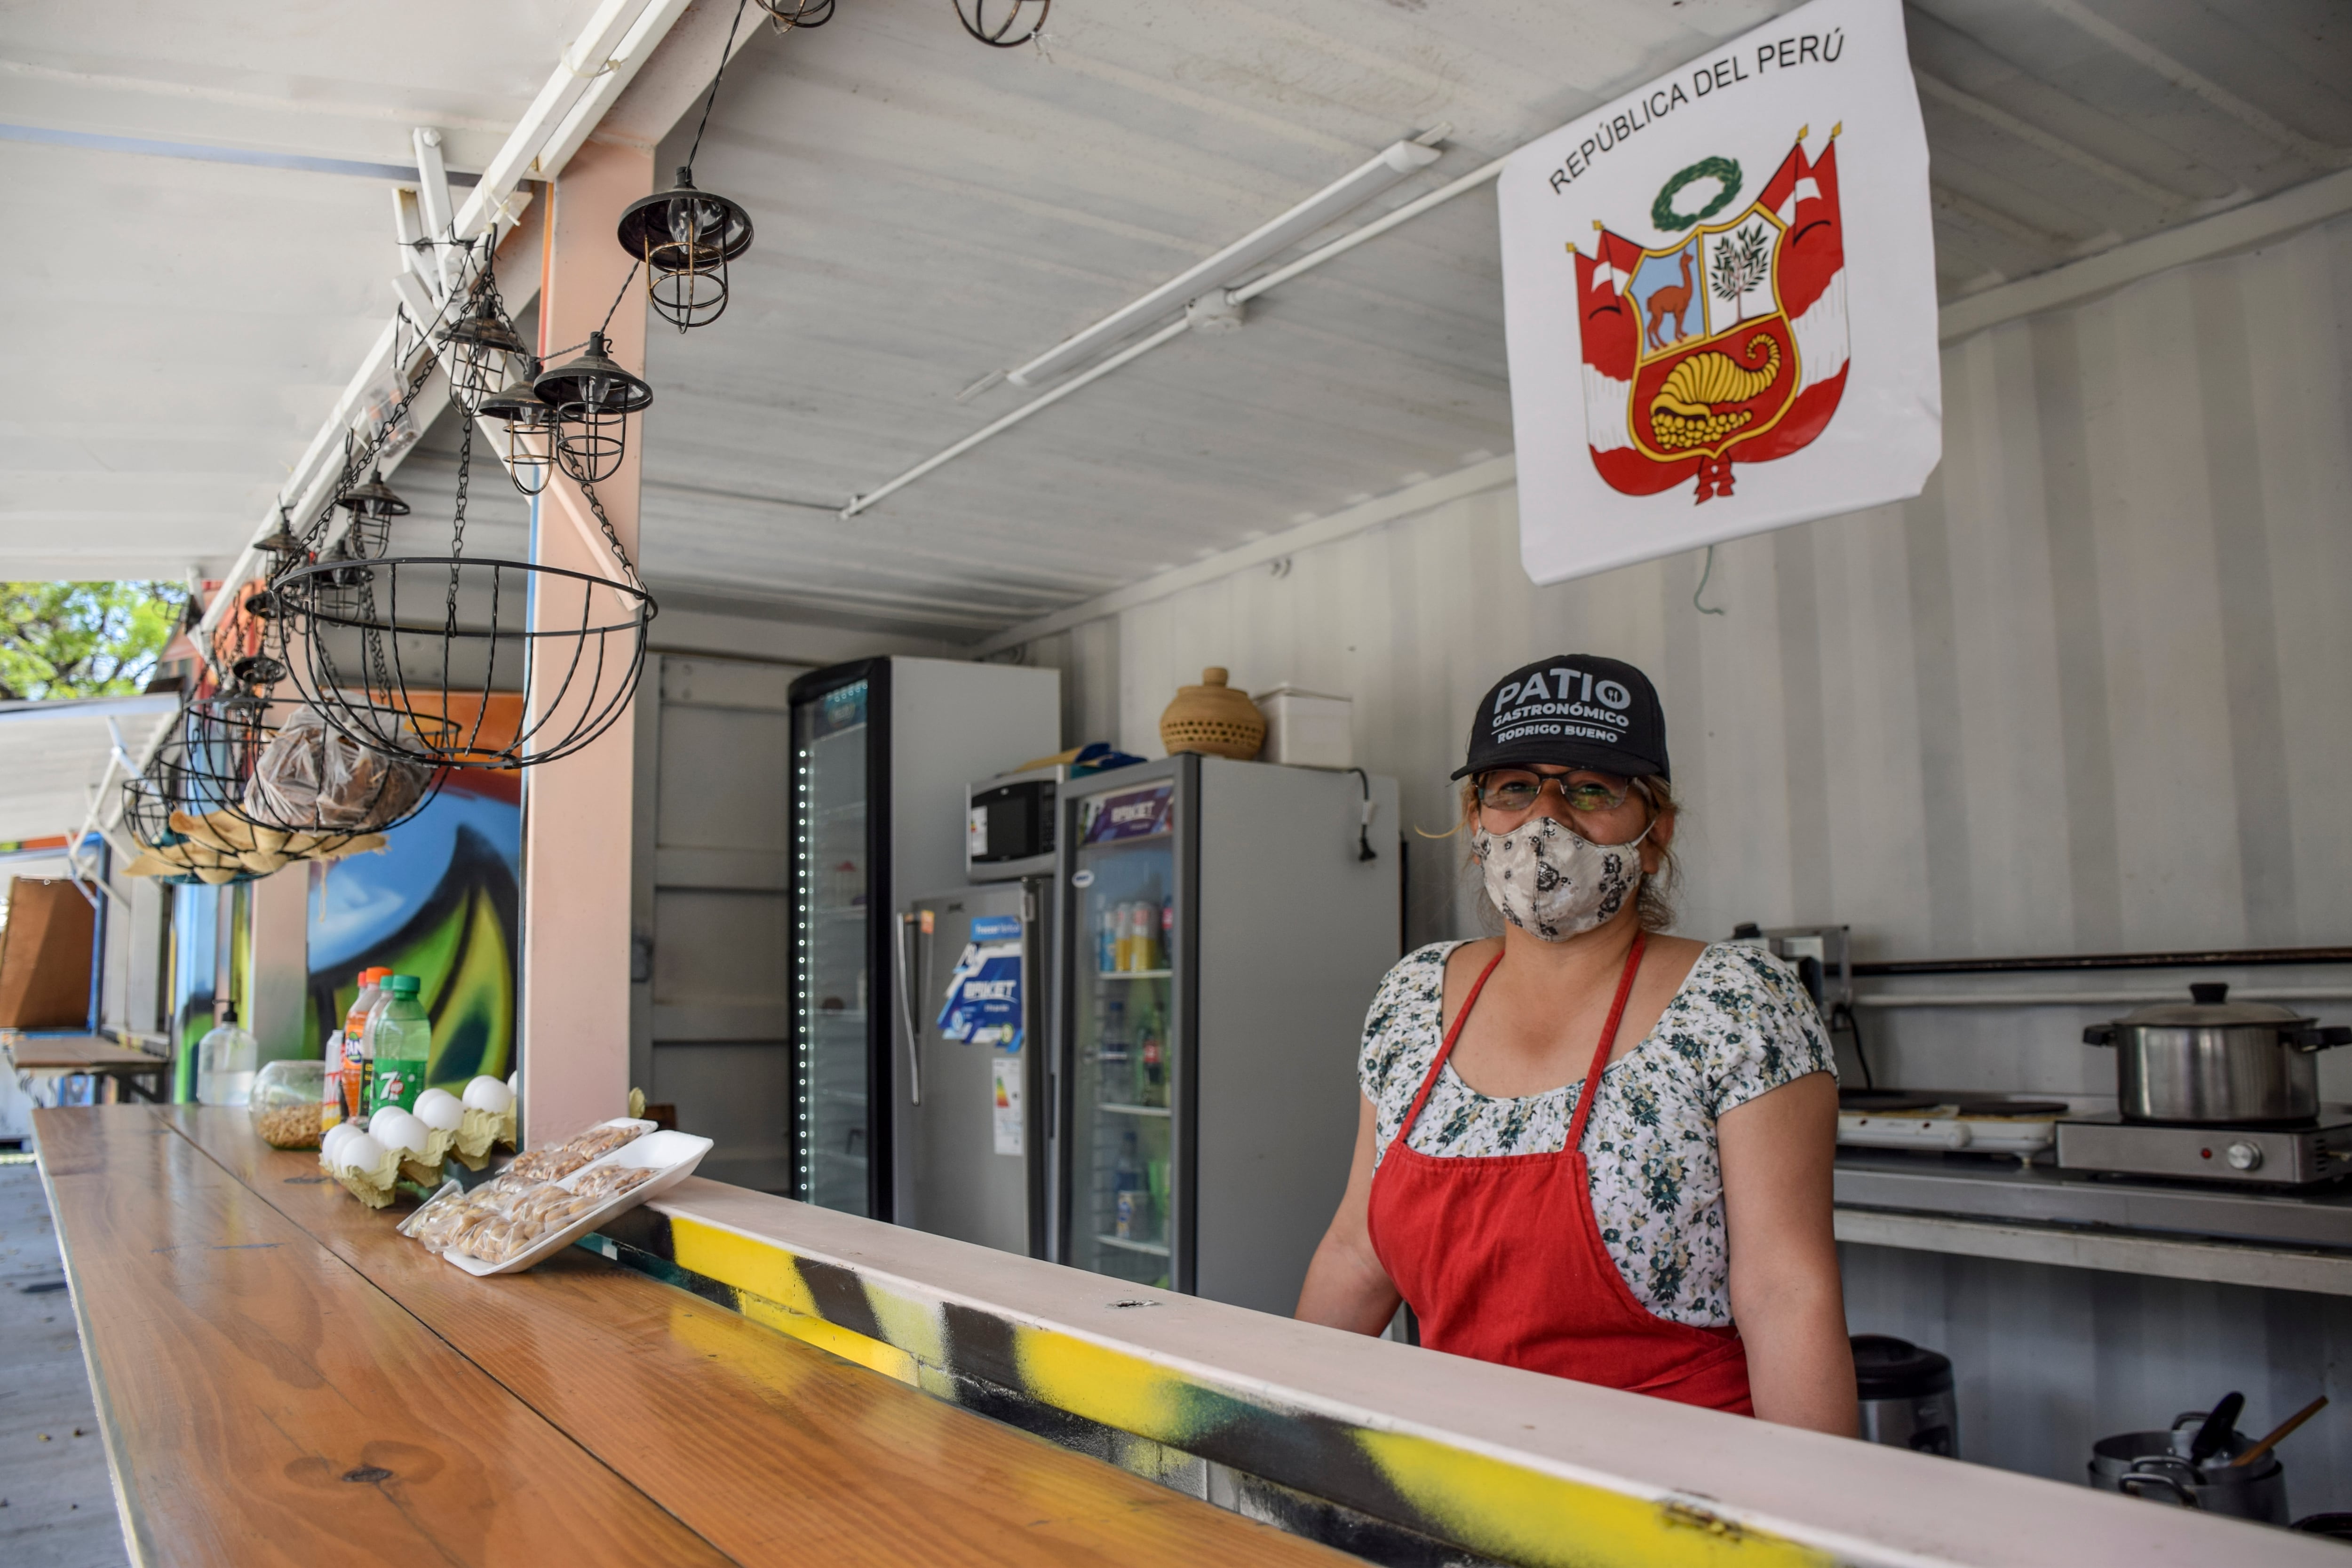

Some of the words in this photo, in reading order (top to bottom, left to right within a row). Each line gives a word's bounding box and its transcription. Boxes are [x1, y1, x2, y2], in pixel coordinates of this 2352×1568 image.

[1549, 83, 1688, 195] REPÚBLICA
[1693, 56, 1749, 97] DEL
[1757, 27, 1844, 74] PERÚ
[1494, 668, 1631, 715] PATIO
[1492, 701, 1629, 727] GASTRONÓMICO
[1497, 724, 1561, 744] RODRIGO
[1564, 725, 1618, 743] BUENO
[345, 1038, 364, 1057] FAN
